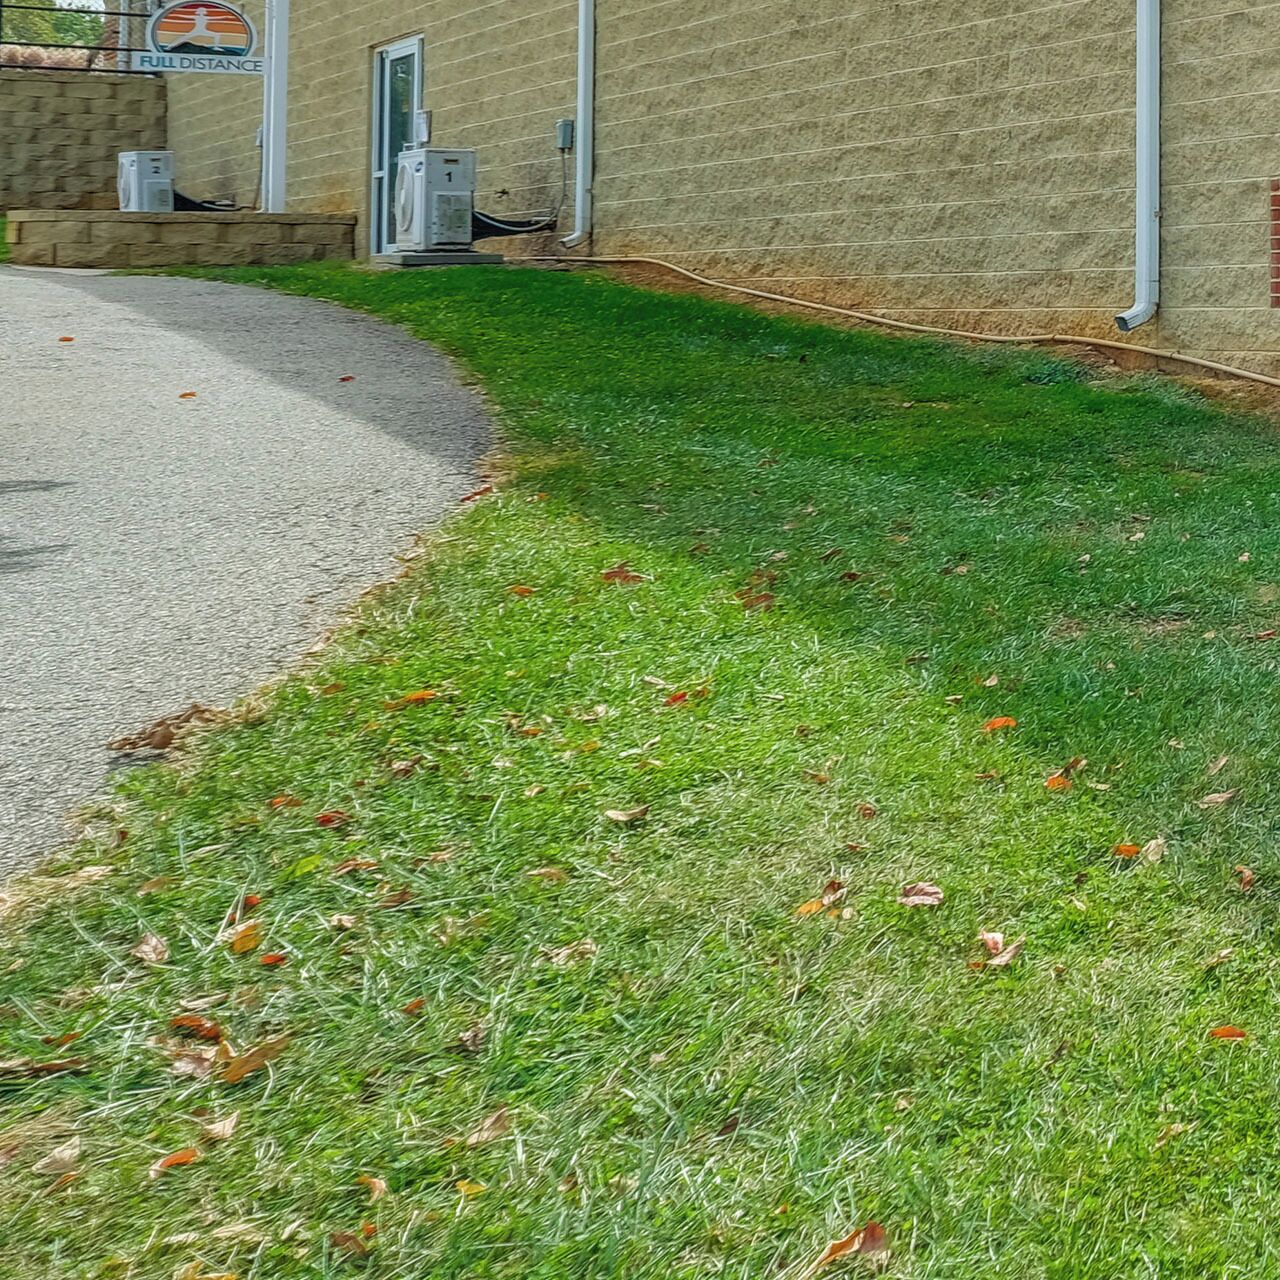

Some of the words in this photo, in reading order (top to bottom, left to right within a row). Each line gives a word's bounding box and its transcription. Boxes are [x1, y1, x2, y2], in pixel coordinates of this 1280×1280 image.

[140, 56, 176, 68] FULL
[179, 57, 263, 72] DISTANCE
[151, 166, 161, 174] 2
[445, 171, 453, 182] 1
